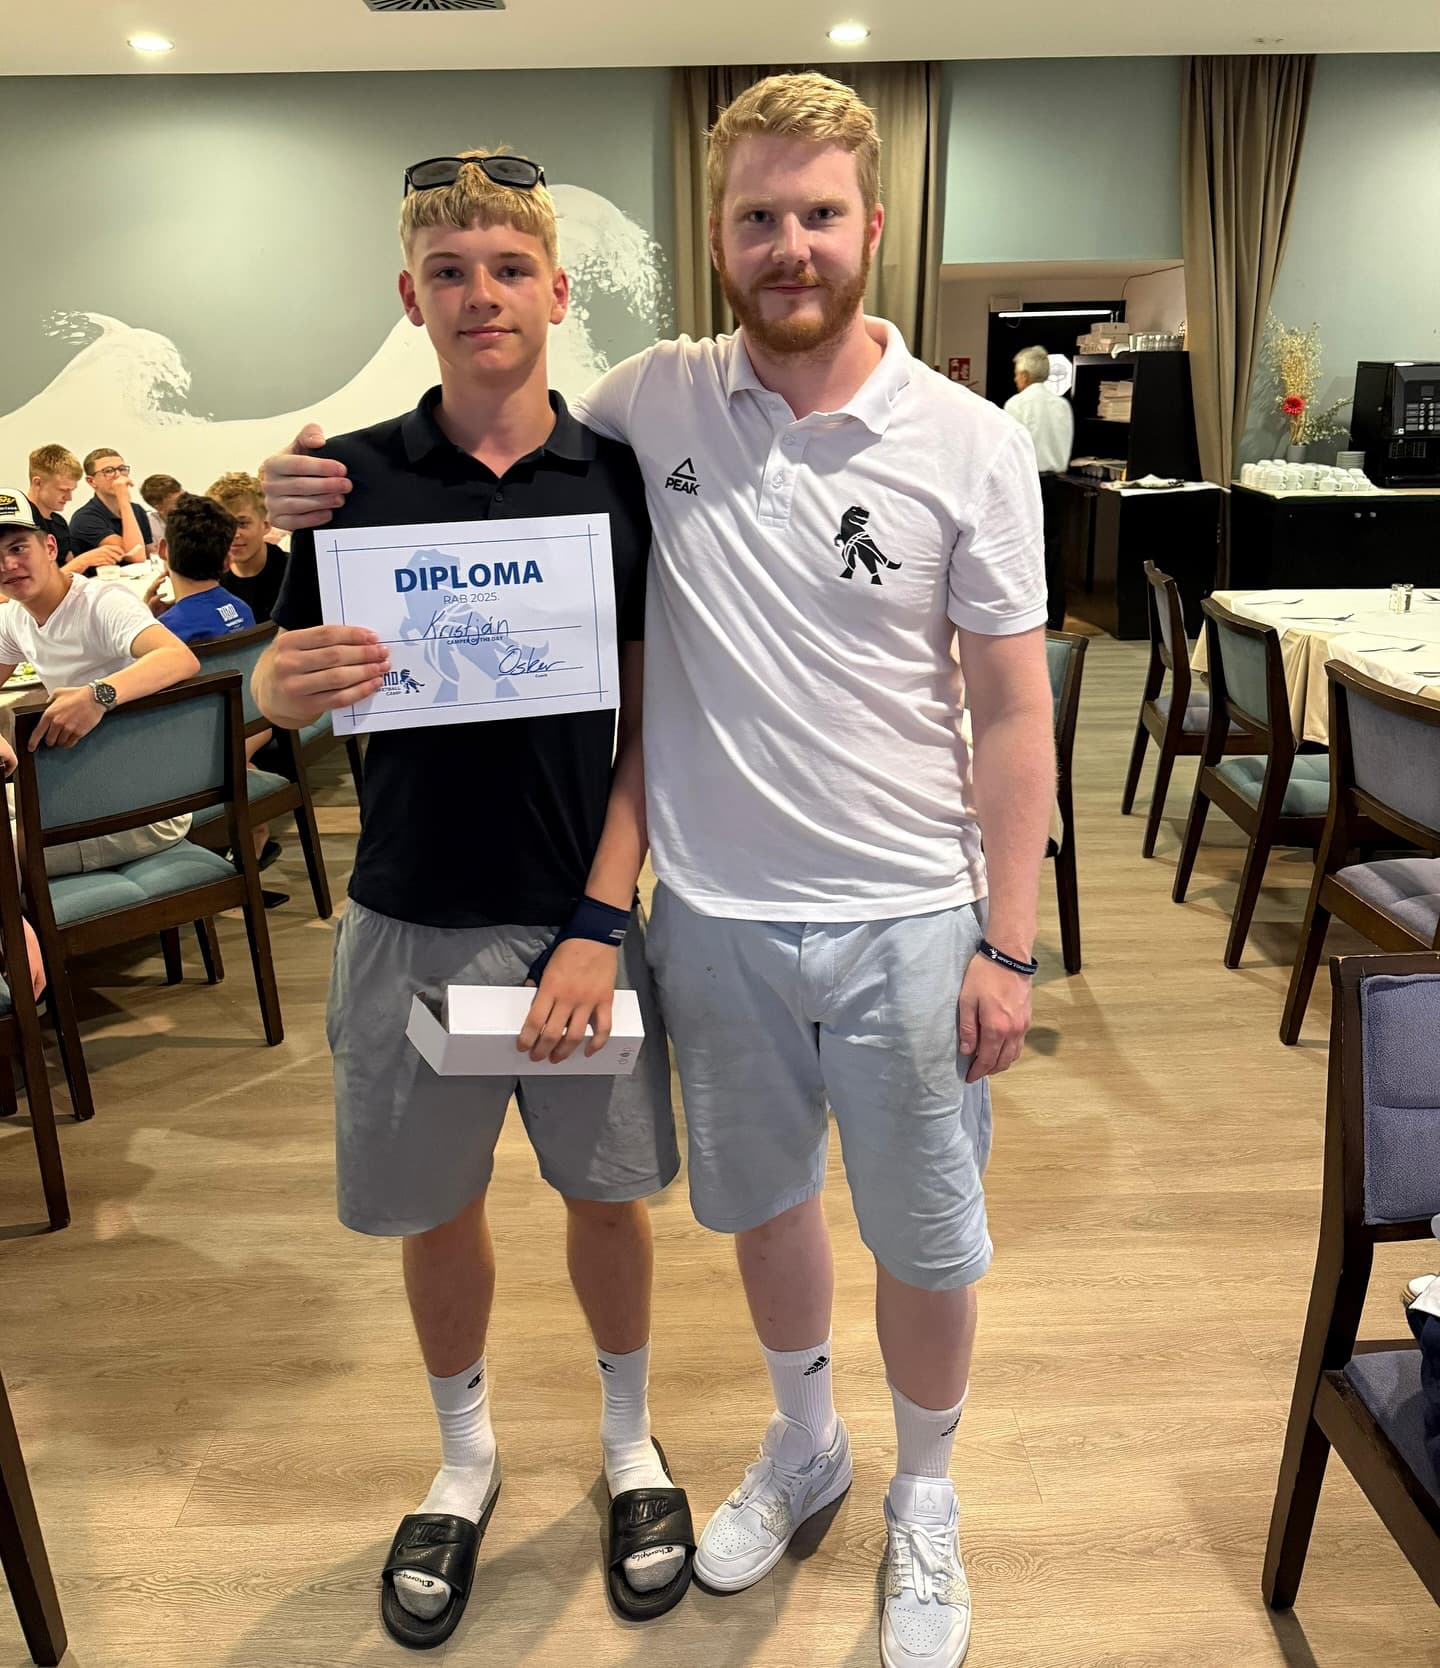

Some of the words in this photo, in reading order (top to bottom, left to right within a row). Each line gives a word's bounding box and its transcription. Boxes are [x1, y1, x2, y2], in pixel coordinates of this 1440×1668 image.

[665, 477, 700, 496] PEAK
[394, 560, 543, 593] DIPLOMA
[443, 594, 468, 604] RAB
